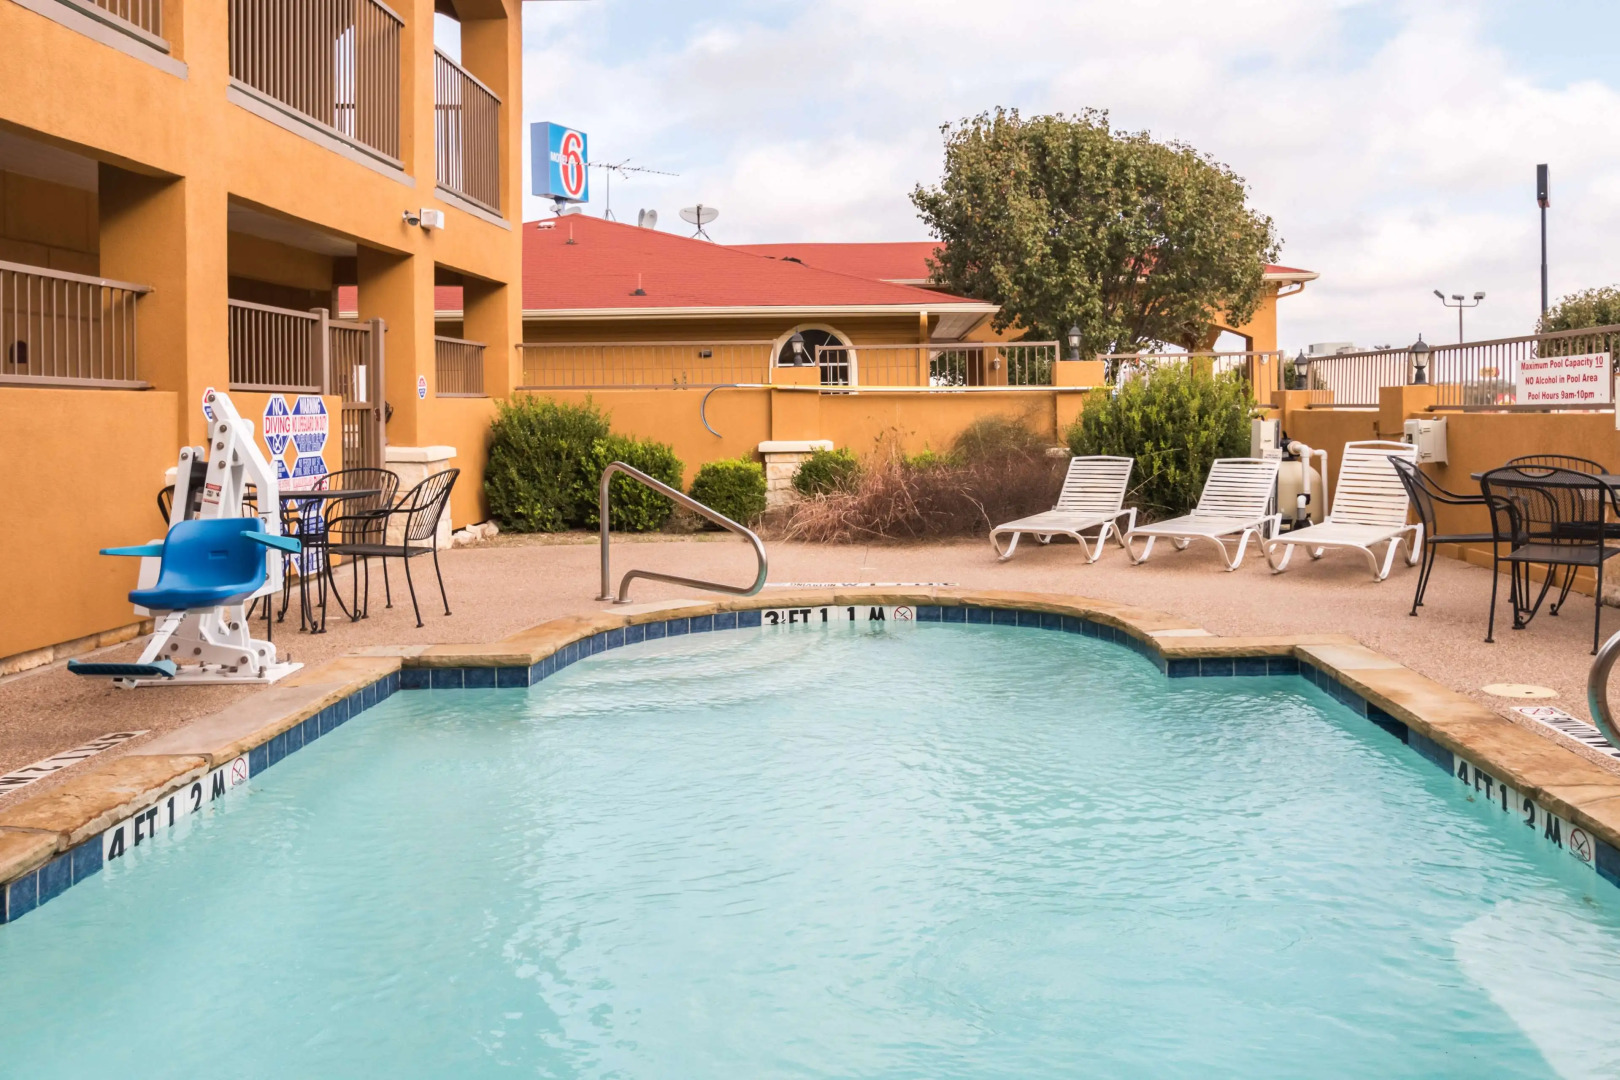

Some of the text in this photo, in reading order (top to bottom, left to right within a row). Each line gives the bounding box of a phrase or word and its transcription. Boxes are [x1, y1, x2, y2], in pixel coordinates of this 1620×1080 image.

[562, 132, 583, 195] 6
[1521, 356, 1603, 370] Maximum Pool Capacity 10
[1525, 373, 1598, 385] NO Alcohol in Pool Area
[1528, 390, 1594, 401] Pool Hours 9am-10pm
[272, 398, 284, 415] NO
[265, 416, 291, 434] DIVING
[789, 609, 811, 623] FT
[1457, 760, 1563, 850] 4 FT 1 2 M
[108, 769, 226, 861] 4 FT 1 2 M
